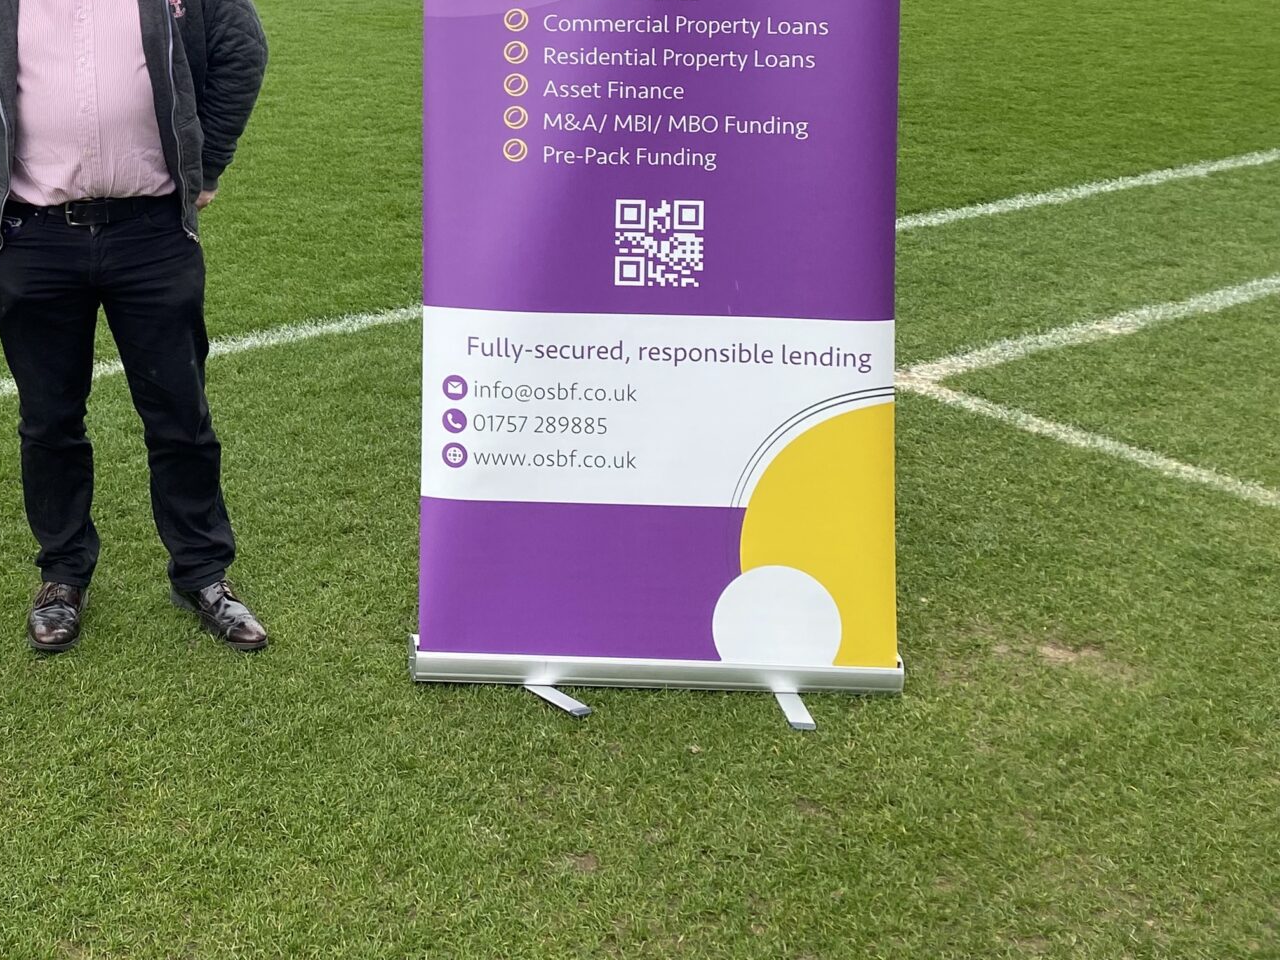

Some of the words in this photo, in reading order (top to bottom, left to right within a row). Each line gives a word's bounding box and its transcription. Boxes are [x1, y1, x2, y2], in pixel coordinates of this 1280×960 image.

[543, 12, 670, 34] Commercial
[675, 15, 761, 39] Property
[767, 16, 829, 36] Loans
[543, 46, 657, 67] Residential
[663, 48, 749, 72] Property
[754, 49, 816, 69] Loans
[542, 80, 602, 99] Asset
[608, 81, 684, 100] Finance
[543, 112, 608, 134] M&A/
[614, 114, 662, 135] MBI/
[668, 115, 719, 133] MBO
[725, 115, 809, 140] Funding
[543, 145, 630, 165] Pre-Pack
[636, 147, 717, 172] Funding
[467, 336, 630, 365] Fully-secured,
[639, 342, 774, 367] responsible
[782, 344, 872, 374] lending
[474, 380, 637, 403] info@osbf.co.uk
[473, 413, 528, 433] 01757
[533, 415, 607, 435] 289885
[473, 449, 637, 469] www.osbf.co.uk
